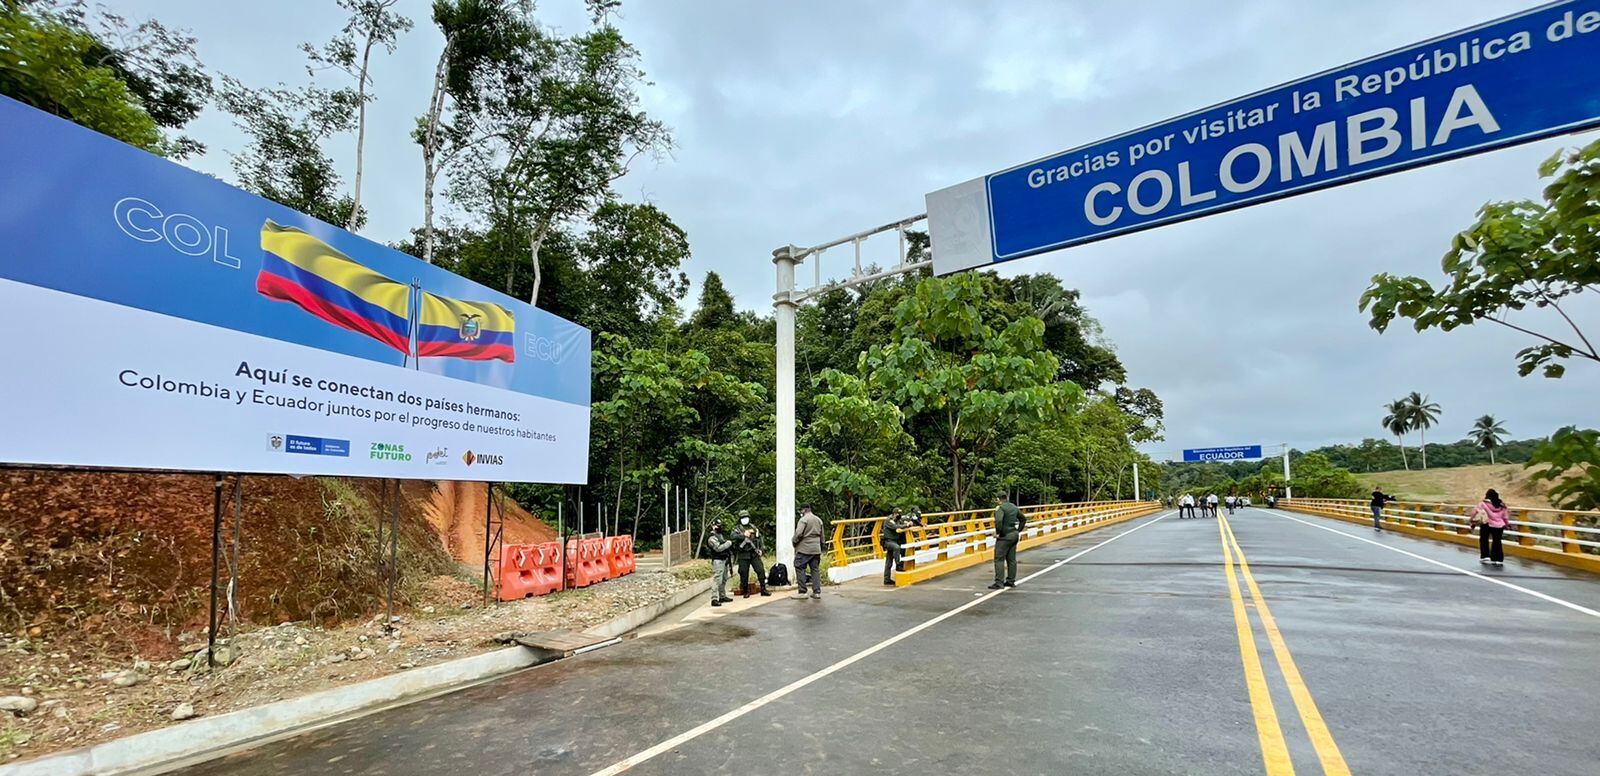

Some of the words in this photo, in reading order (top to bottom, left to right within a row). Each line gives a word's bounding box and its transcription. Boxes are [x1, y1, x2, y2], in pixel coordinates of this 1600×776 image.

[1027, 149, 1120, 189] Gracias
[1128, 132, 1175, 165] por
[1182, 100, 1279, 144] visitar
[1293, 91, 1322, 114] la
[1335, 30, 1531, 102] República
[1546, 10, 1600, 43] de
[1084, 83, 1501, 226] COLOMBIA
[113, 196, 241, 269] COL
[524, 331, 562, 364] ECU
[118, 369, 231, 400] Colombia
[236, 390, 247, 405] y
[252, 389, 324, 412] Ecuador
[326, 401, 371, 418] juntos
[374, 409, 396, 422] por
[399, 412, 410, 423] el
[412, 415, 461, 431] progreso
[462, 421, 475, 432] de
[477, 424, 515, 437] nuestros
[516, 428, 557, 442] habitantes
[235, 361, 288, 385] Aquí
[292, 374, 313, 388] se
[317, 379, 394, 402] conectan
[397, 390, 422, 406] dos
[425, 397, 464, 413] países
[466, 402, 521, 422] hermanos:
[370, 451, 412, 461] FUTURO
[371, 442, 404, 452] ZONAS
[477, 453, 503, 466] INVIAS
[1199, 452, 1244, 460] ECUADOR
